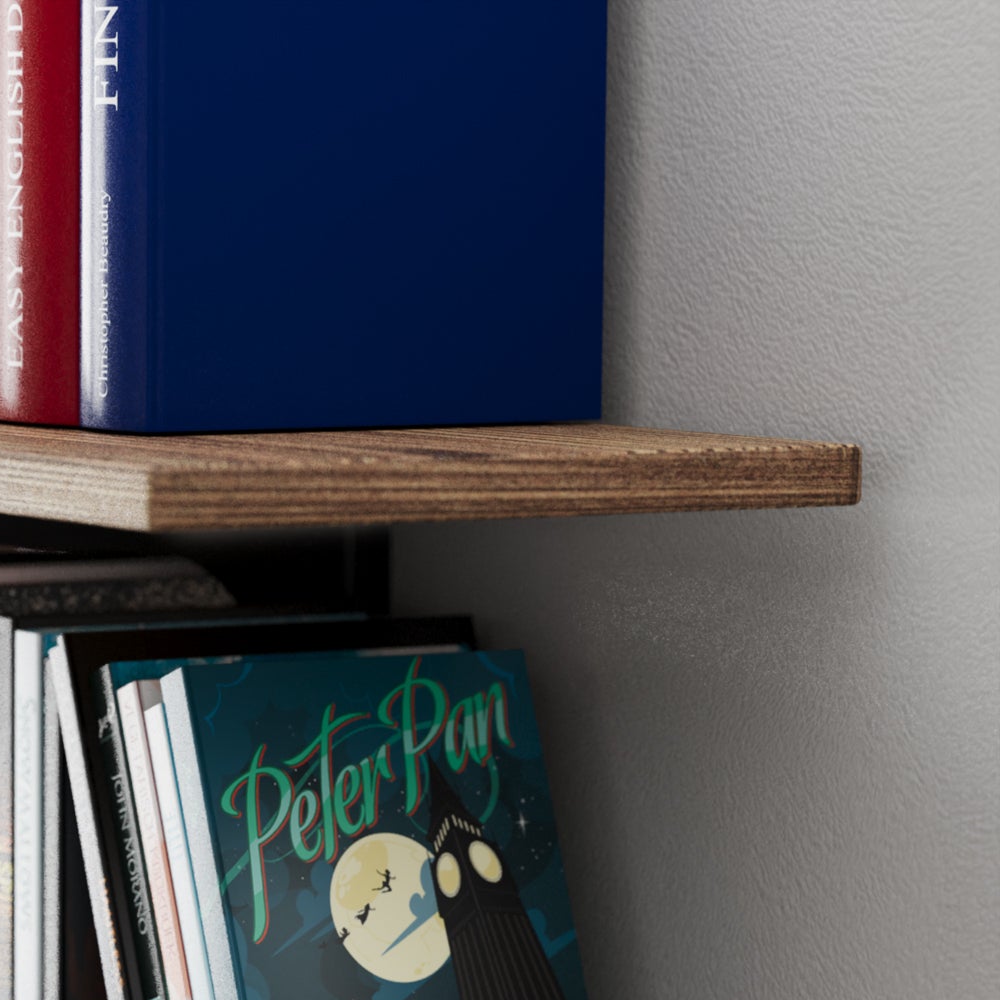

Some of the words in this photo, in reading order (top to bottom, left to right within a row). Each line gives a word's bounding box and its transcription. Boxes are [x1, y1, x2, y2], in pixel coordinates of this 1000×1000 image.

[94, 5, 118, 111] FIN
[7, 48, 23, 239] ENGLISH
[97, 190, 111, 273] Beaudry
[7, 256, 23, 369] EASY
[97, 279, 111, 398] Christopher
[111, 774, 135, 837] JOHN
[123, 838, 148, 936] MORANO
[221, 703, 396, 944] Peter
[378, 656, 516, 816] Pan
